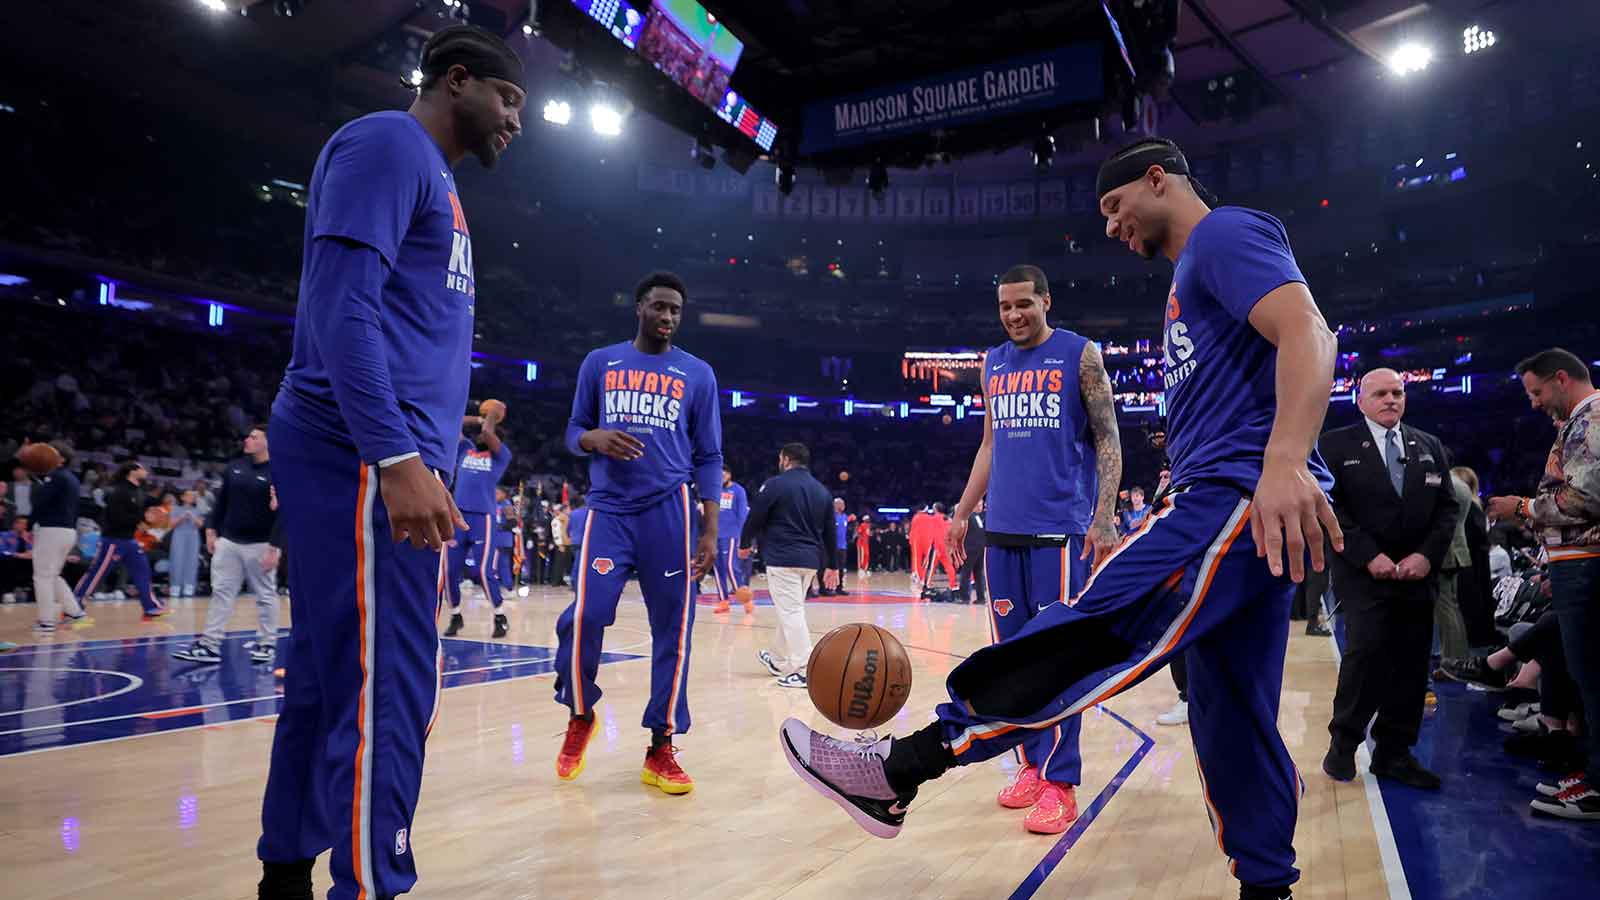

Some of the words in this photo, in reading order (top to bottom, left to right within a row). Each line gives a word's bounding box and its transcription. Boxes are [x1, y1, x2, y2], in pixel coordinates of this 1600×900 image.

[834, 93, 908, 131] MADISON
[912, 77, 979, 115] SQUARE
[983, 61, 1056, 100] GARDEN
[605, 369, 685, 400] ALWAYS
[989, 369, 1063, 396] ALWAYS
[605, 390, 680, 422] KNICKS
[990, 392, 1061, 419] KNICKS
[1023, 418, 1060, 429] FOREVER
[847, 648, 879, 719] Wilson
